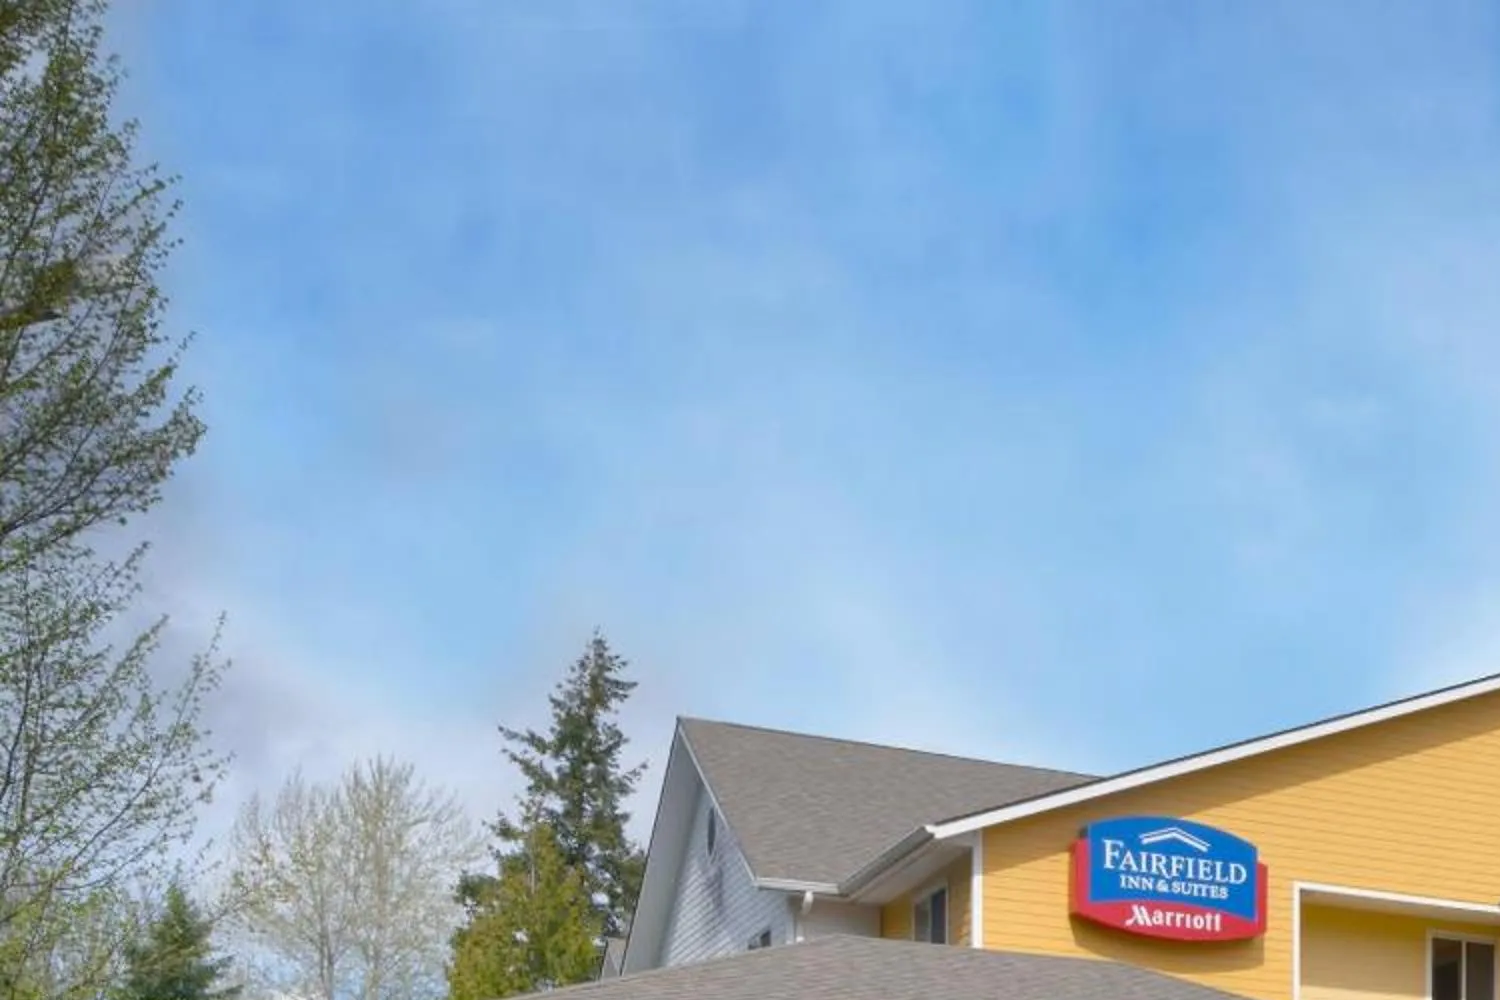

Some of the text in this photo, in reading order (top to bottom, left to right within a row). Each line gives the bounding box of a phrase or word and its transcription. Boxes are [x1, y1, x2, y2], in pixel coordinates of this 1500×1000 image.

[1103, 839, 1247, 884] FAIRFIELD
[1119, 875, 1228, 899] INN & SUITES
[1125, 904, 1222, 932] Marriott
